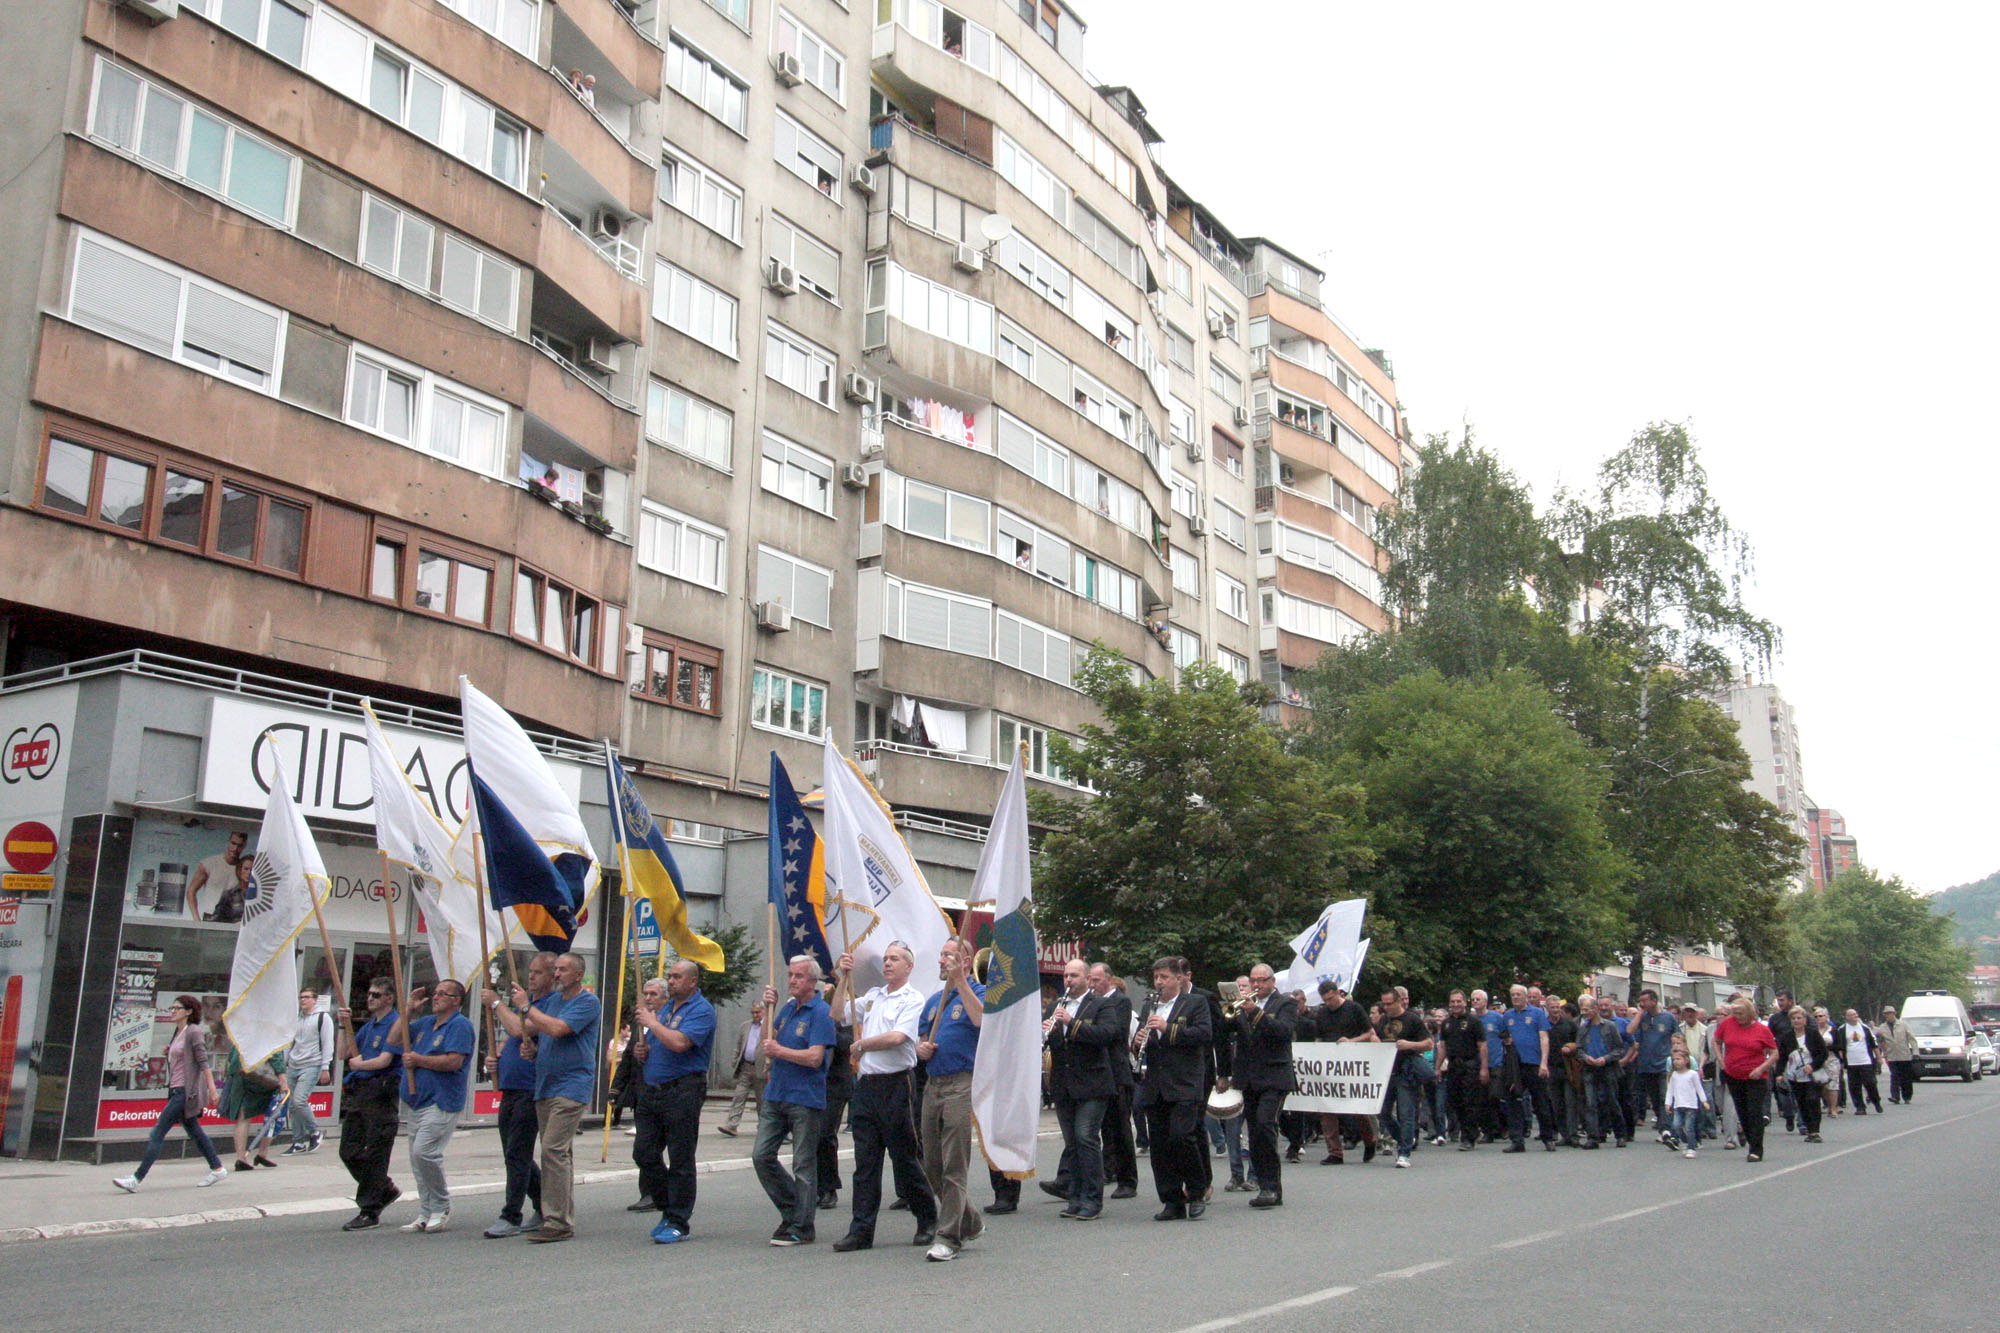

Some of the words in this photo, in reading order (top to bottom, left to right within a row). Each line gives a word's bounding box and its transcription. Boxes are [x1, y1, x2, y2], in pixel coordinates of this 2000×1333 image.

[13, 748, 48, 764] SHOP
[864, 857, 883, 876] MUP
[640, 902, 653, 925] P
[637, 926, 655, 937] TAXI
[1326, 1060, 1370, 1077] PAMTE
